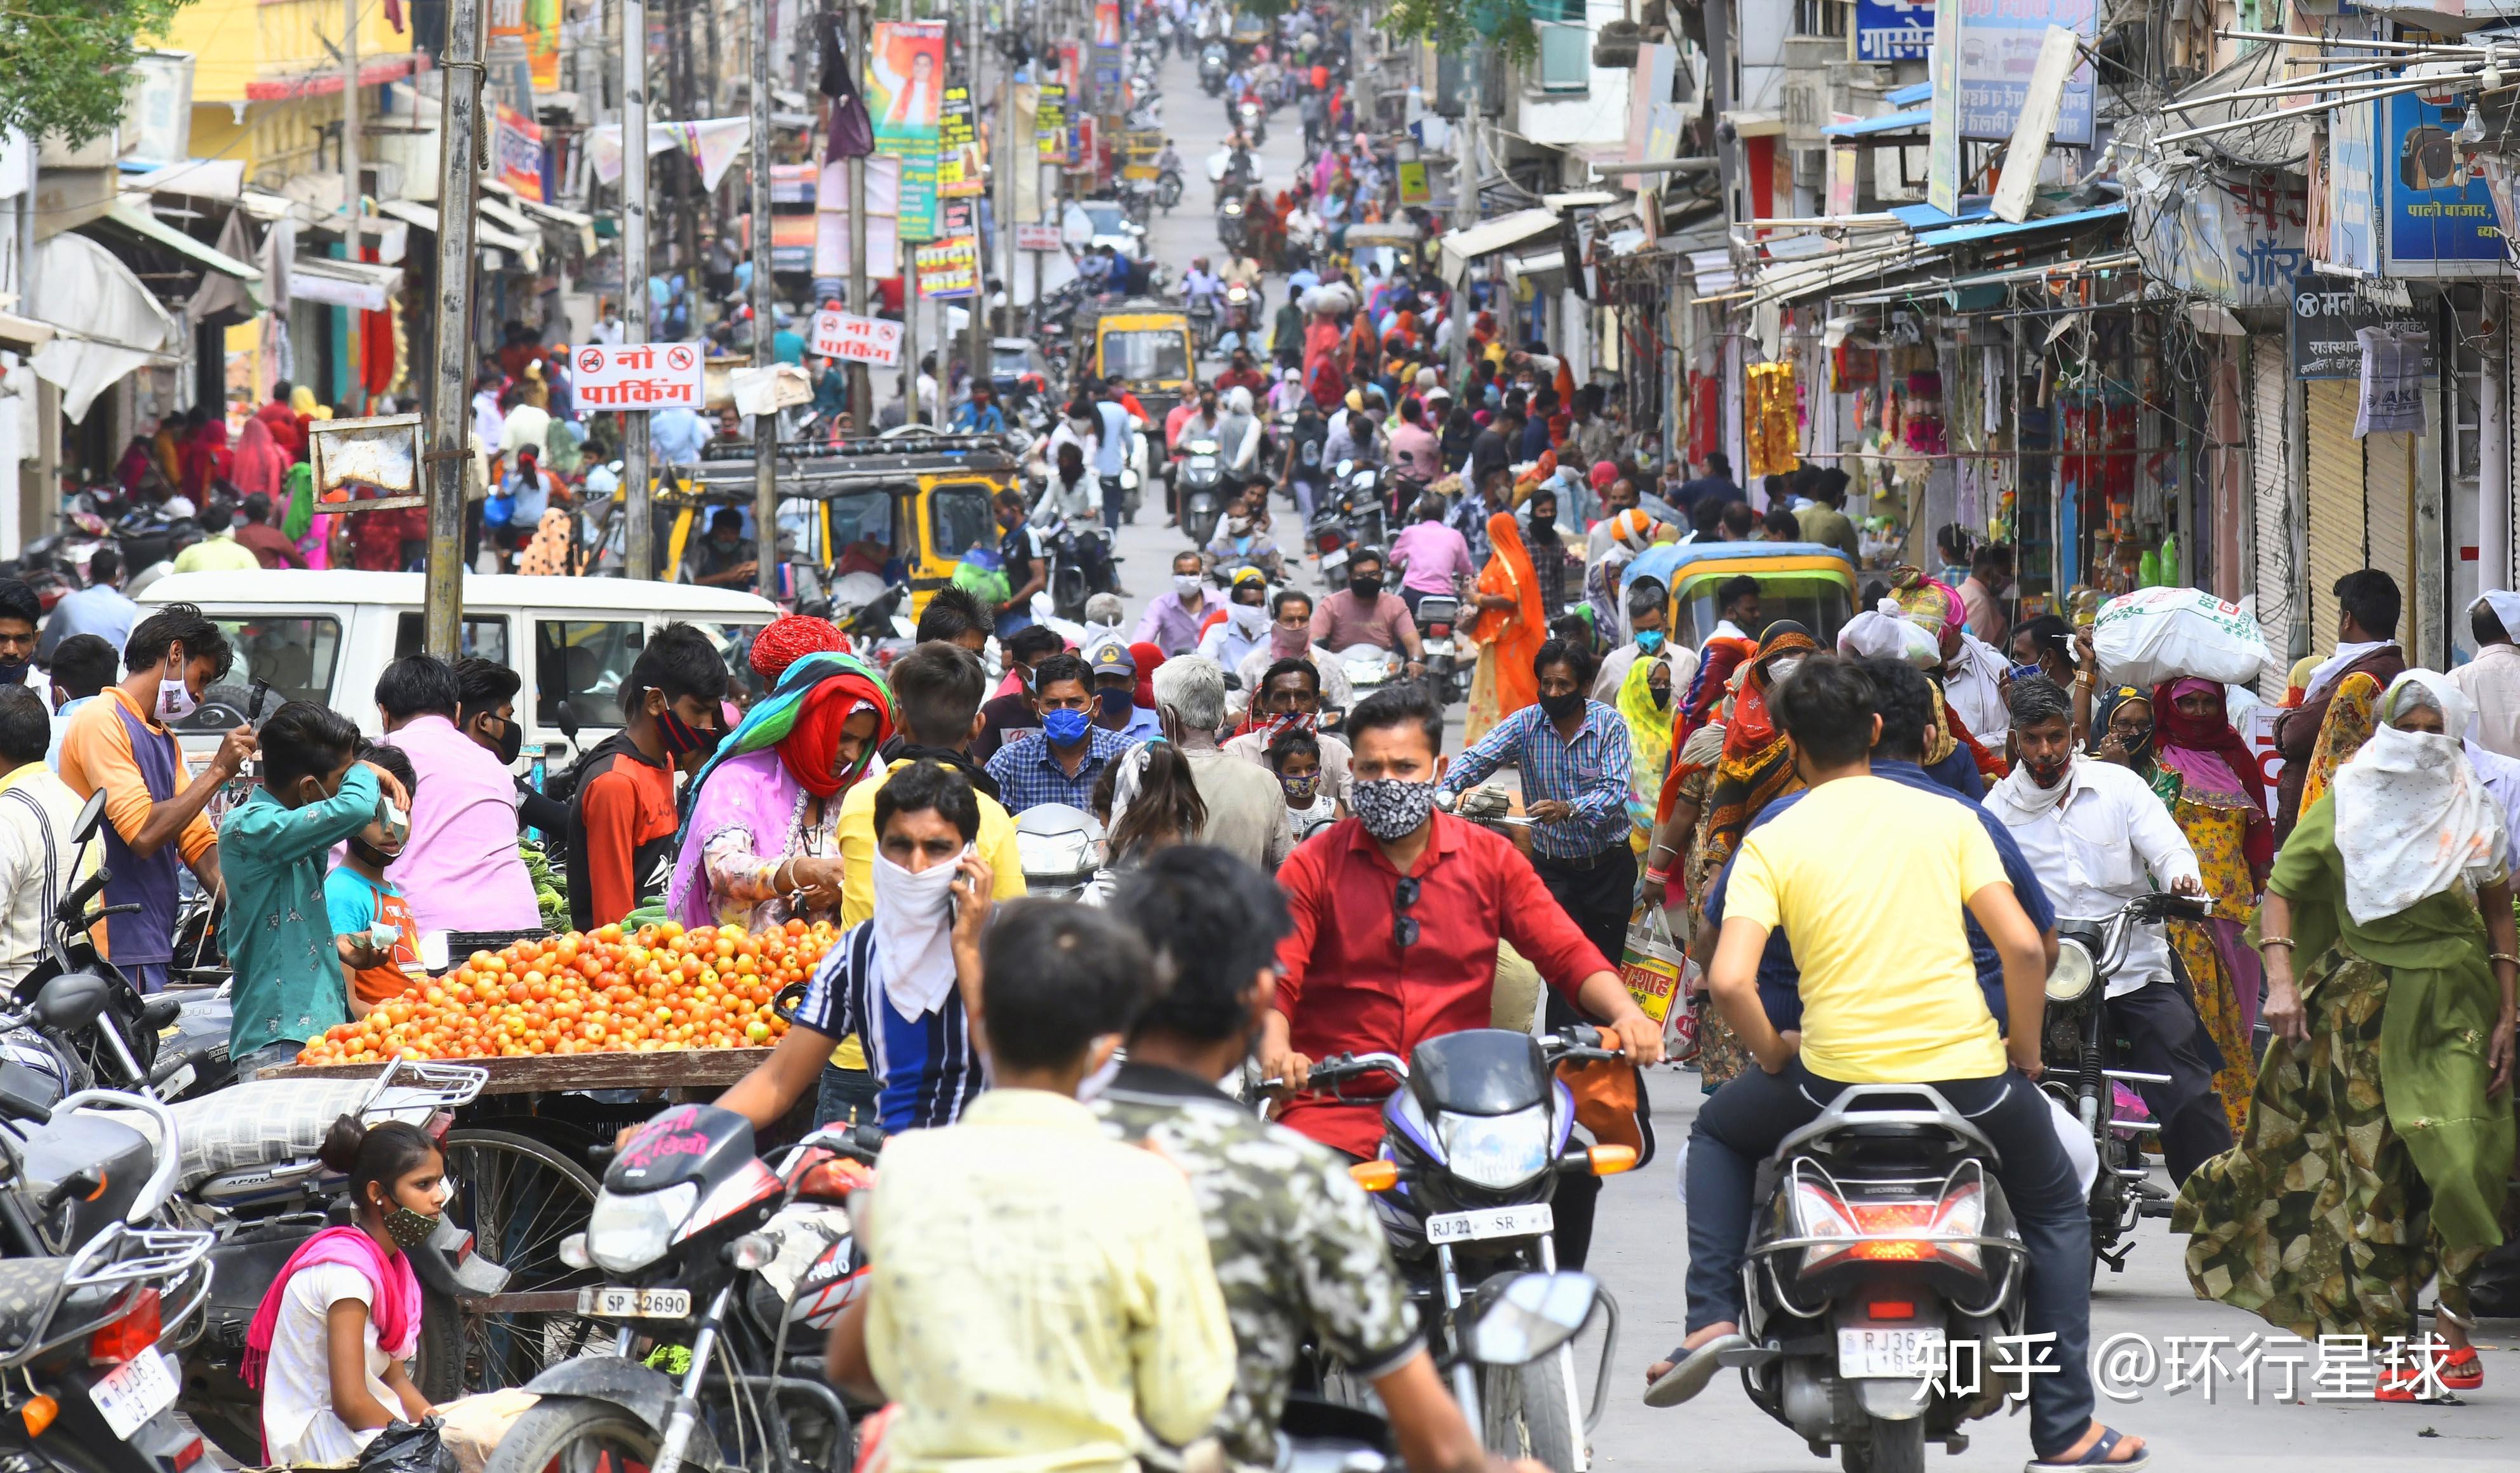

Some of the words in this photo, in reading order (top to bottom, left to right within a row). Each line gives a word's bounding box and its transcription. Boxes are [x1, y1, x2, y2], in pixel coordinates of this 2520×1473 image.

[2408, 201, 2441, 217] पाली
[2477, 225, 2503, 239] ब्या
[615, 345, 657, 370] नो
[580, 378, 694, 404] पार्किंग
[607, 1295, 625, 1312] SP
[644, 1296, 685, 1313] 2690
